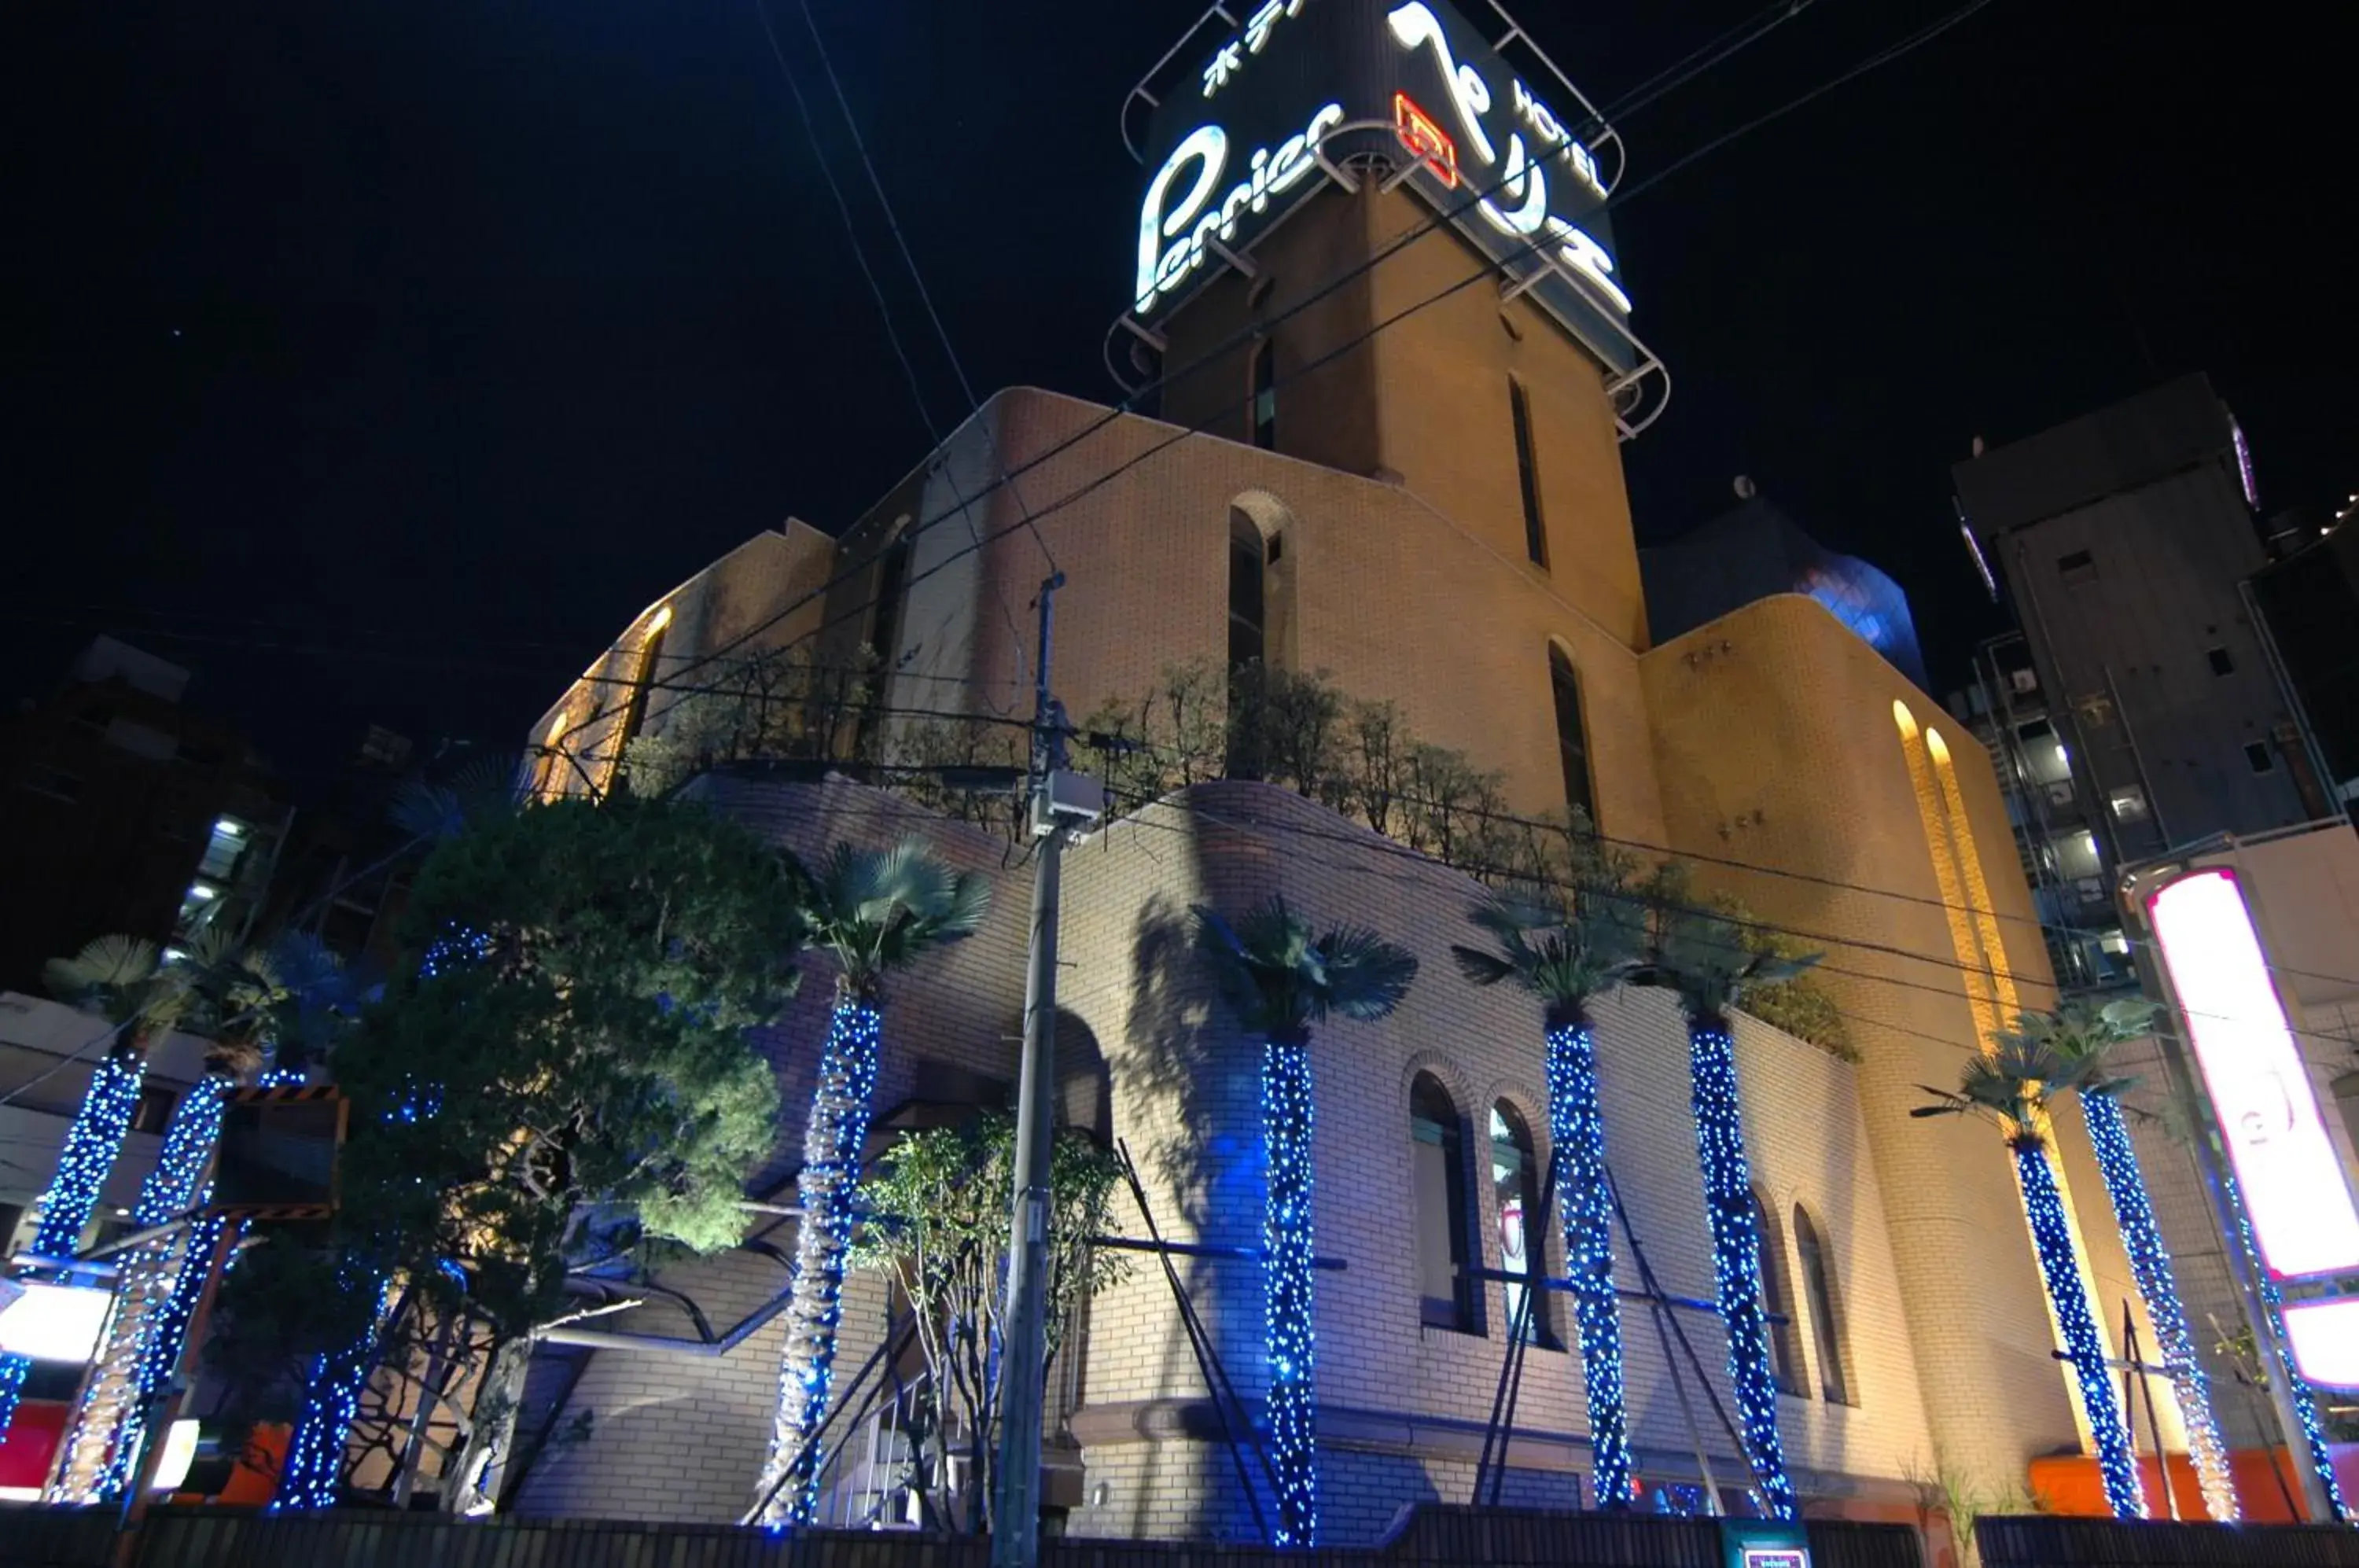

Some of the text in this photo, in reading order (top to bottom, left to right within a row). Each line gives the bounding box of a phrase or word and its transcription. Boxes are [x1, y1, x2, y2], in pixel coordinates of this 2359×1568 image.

[1135, 102, 1344, 315] Perrier
[1387, 1, 1632, 315] ペリエ
[1512, 78, 1609, 201] HOTEL
